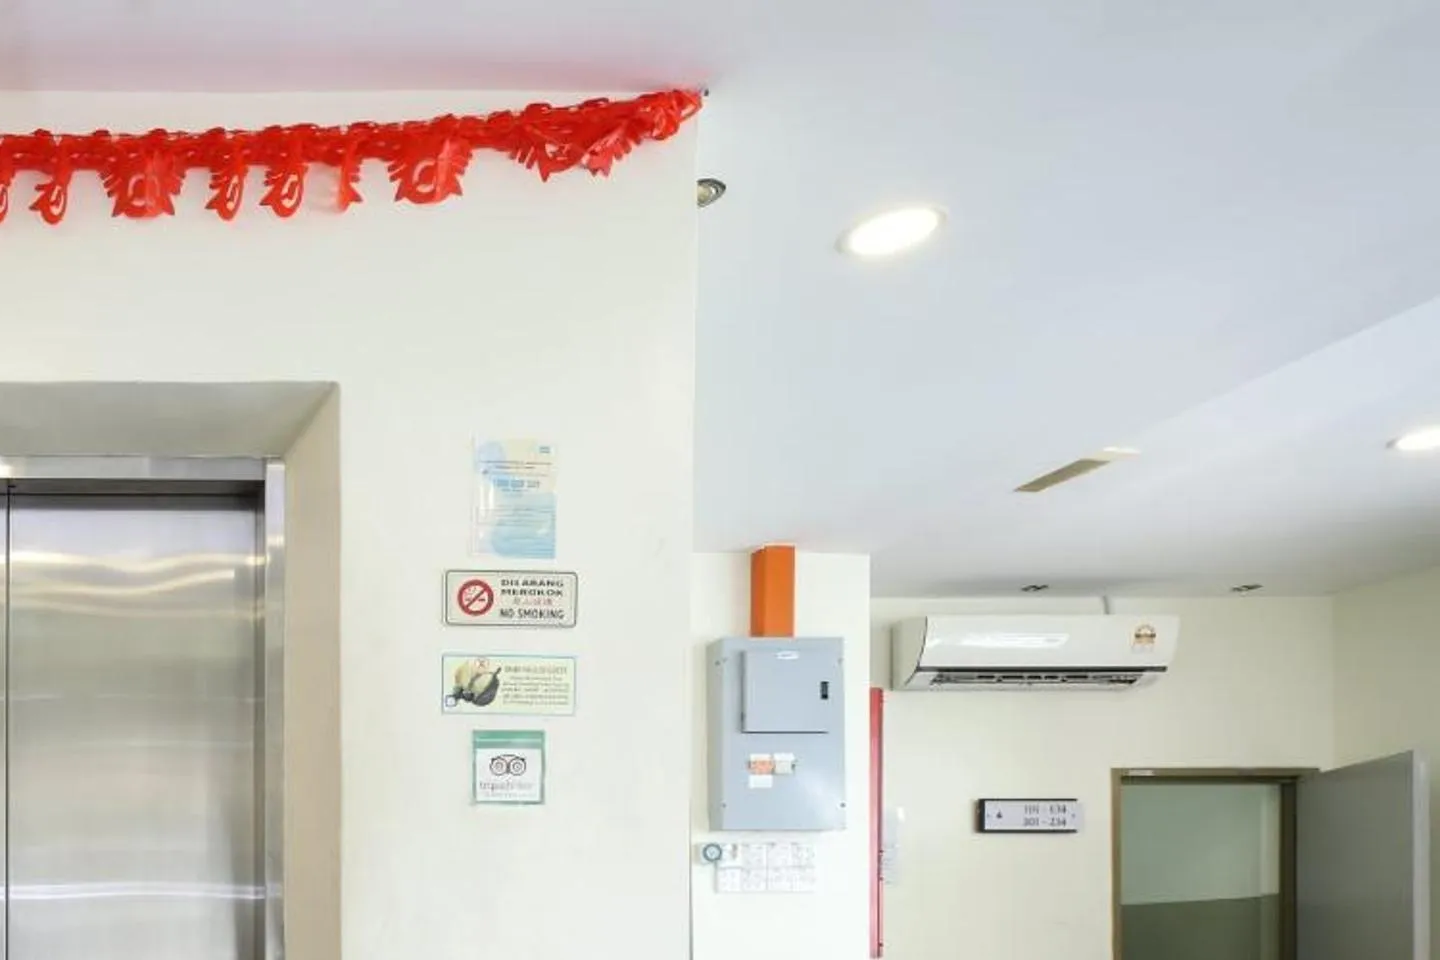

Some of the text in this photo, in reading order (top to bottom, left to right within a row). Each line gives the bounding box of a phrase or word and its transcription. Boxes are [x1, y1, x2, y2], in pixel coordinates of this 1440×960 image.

[500, 579, 564, 588] DILARANG
[500, 588, 563, 597] MEROKOK
[500, 608, 565, 619] NO SMOKING
[479, 780, 534, 792] tripad
